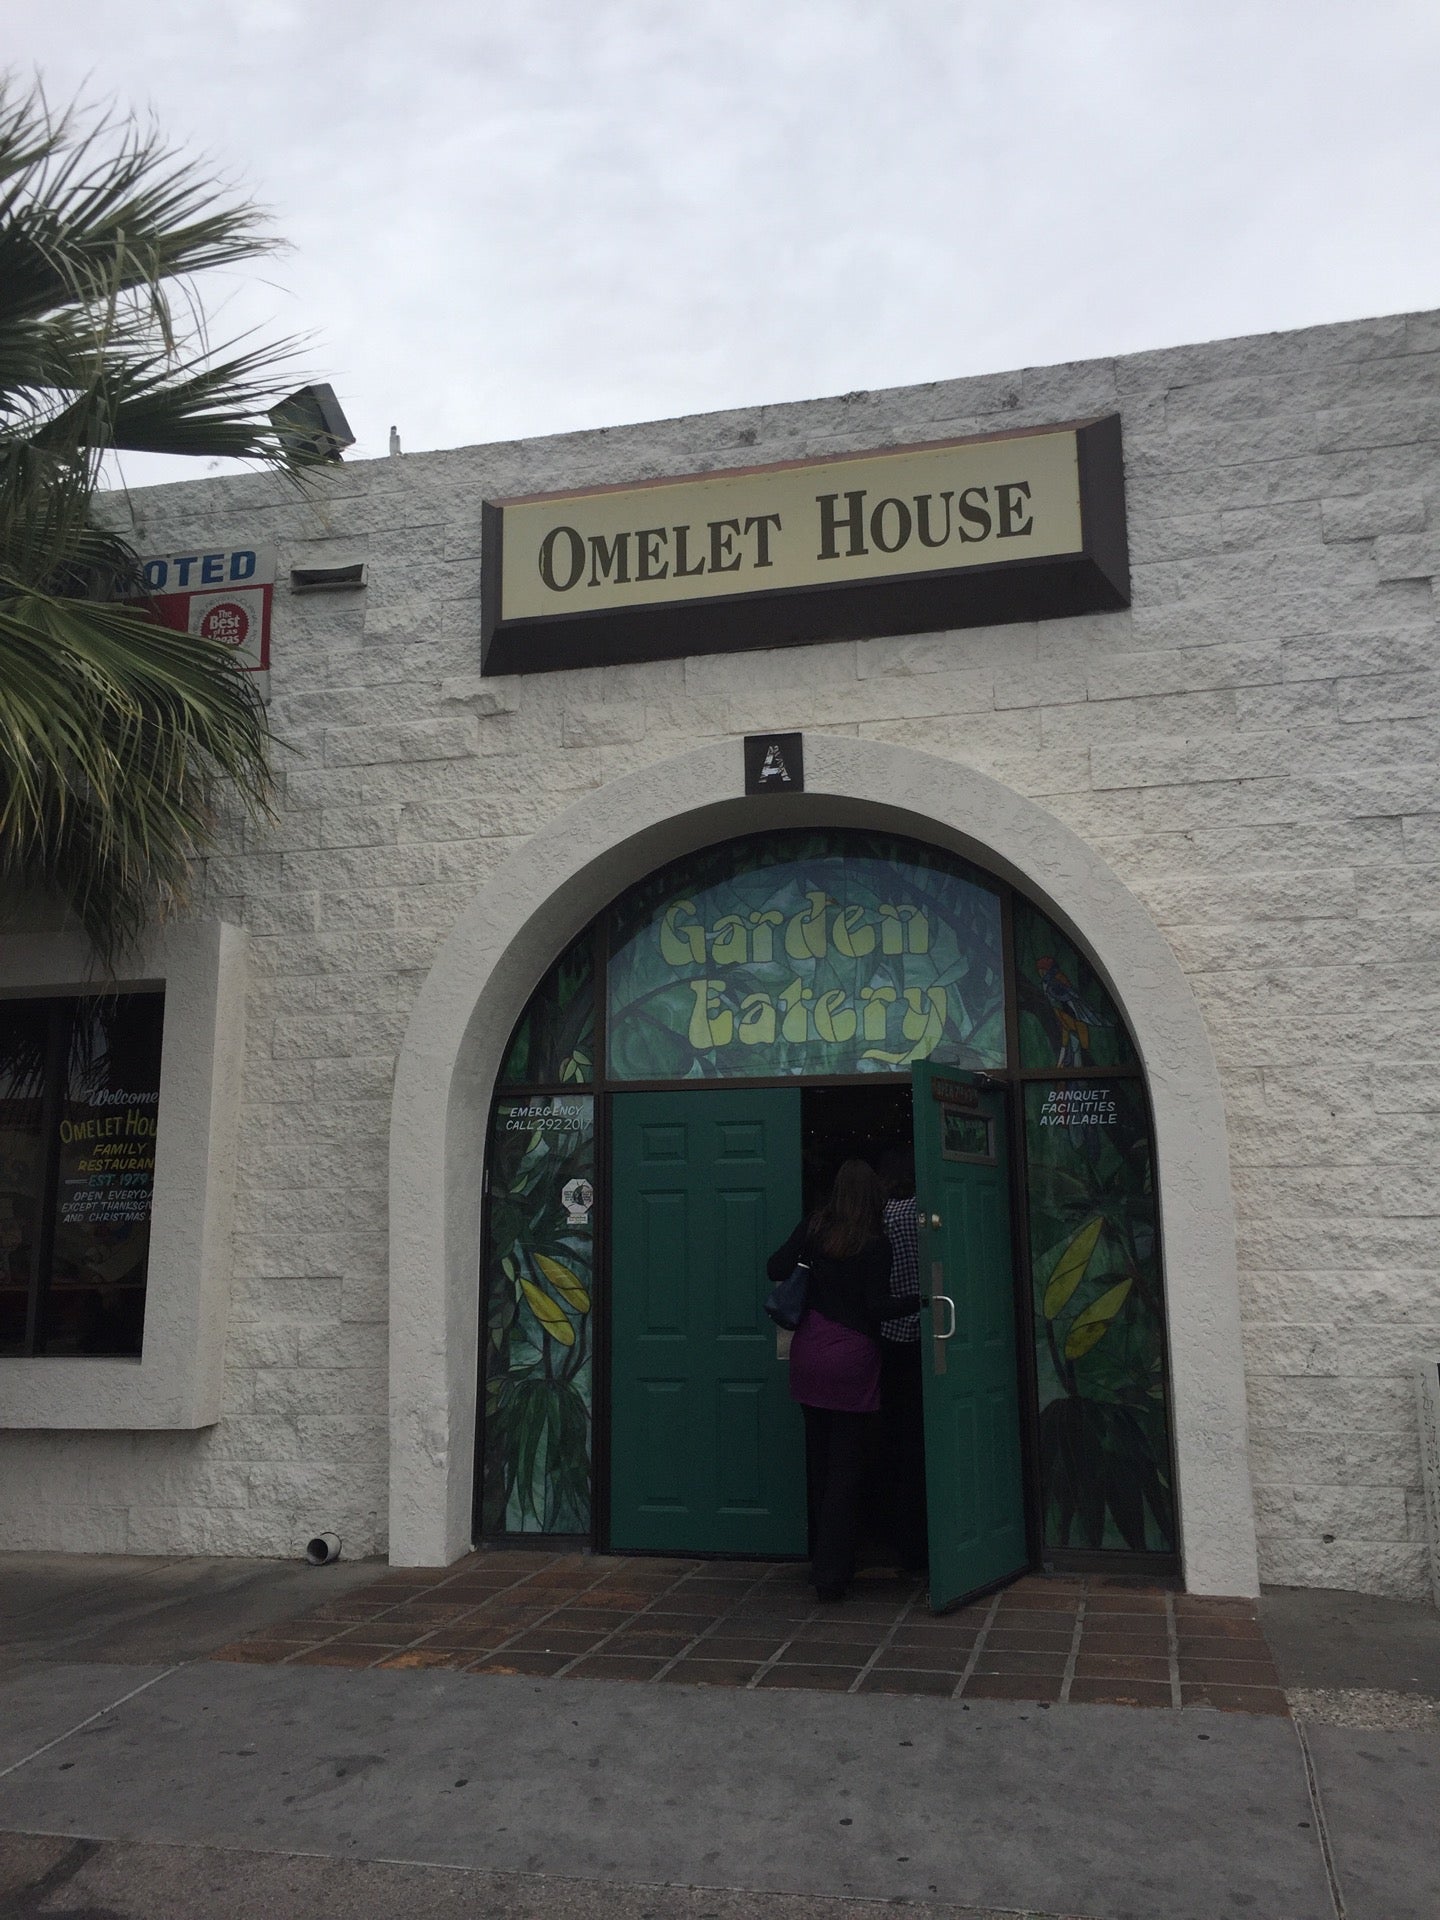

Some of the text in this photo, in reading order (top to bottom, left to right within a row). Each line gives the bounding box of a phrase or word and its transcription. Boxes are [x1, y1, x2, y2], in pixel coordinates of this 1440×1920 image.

[539, 481, 1034, 592] OMELET HOUSE
[218, 609, 232, 618] The
[210, 615, 240, 629] Best
[758, 745, 791, 783] A
[660, 891, 929, 966] Garden
[688, 977, 947, 1064] Eatery
[86, 1088, 158, 1107] Welcome
[1048, 1089, 1110, 1102] BANQUET
[510, 1105, 583, 1118] EMERGENCY
[1041, 1101, 1116, 1113] FACILITIES
[60, 1108, 157, 1144] OMELET HOU
[506, 1119, 592, 1130] CALL 292 2017
[1040, 1113, 1118, 1126] AVAILABLE
[93, 1143, 147, 1156] FAMILY
[78, 1157, 155, 1171] RESTAURAN
[120, 1173, 148, 1186] 1979
[74, 1191, 103, 1201] OPEN
[62, 1202, 98, 1213] EXCEPT
[63, 1212, 146, 1223] AND CHRISTMAS
